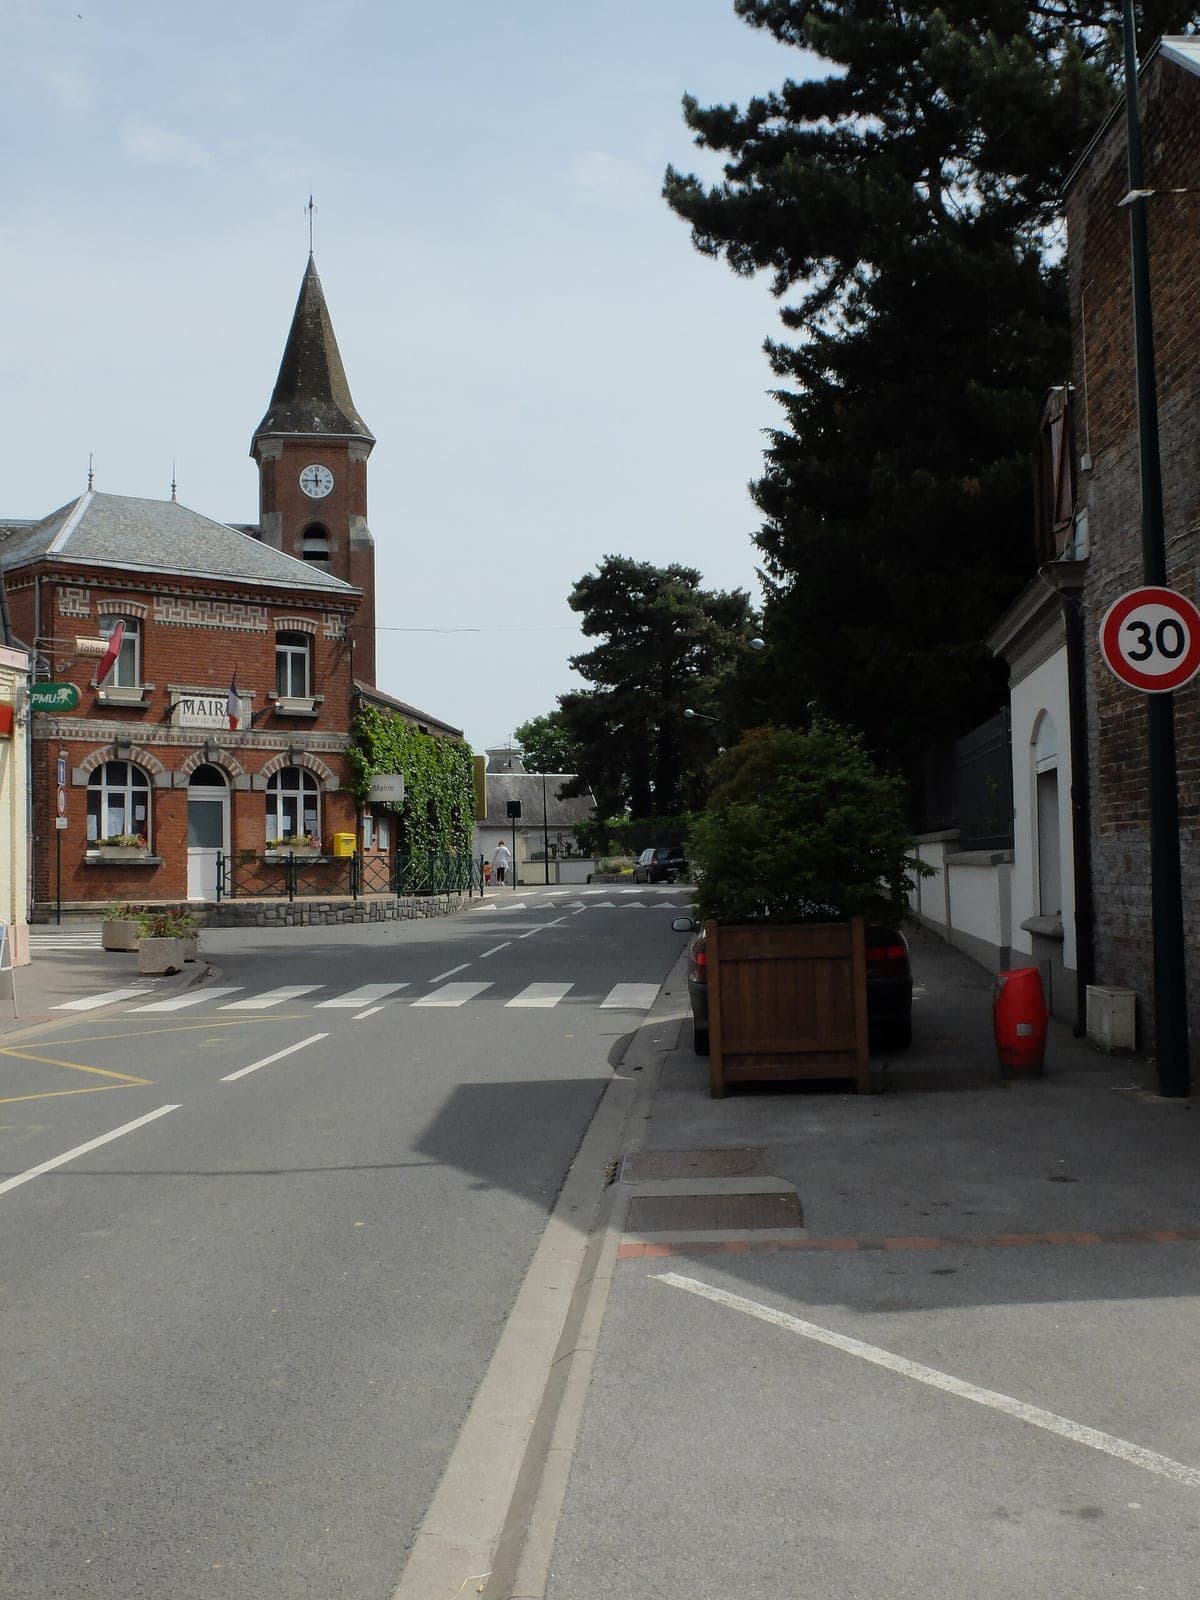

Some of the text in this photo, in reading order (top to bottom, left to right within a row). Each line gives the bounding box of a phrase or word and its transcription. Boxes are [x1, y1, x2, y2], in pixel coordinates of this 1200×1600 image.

[1126, 618, 1185, 661] 30
[32, 693, 56, 704] PMU
[372, 783, 395, 793] Mairie
